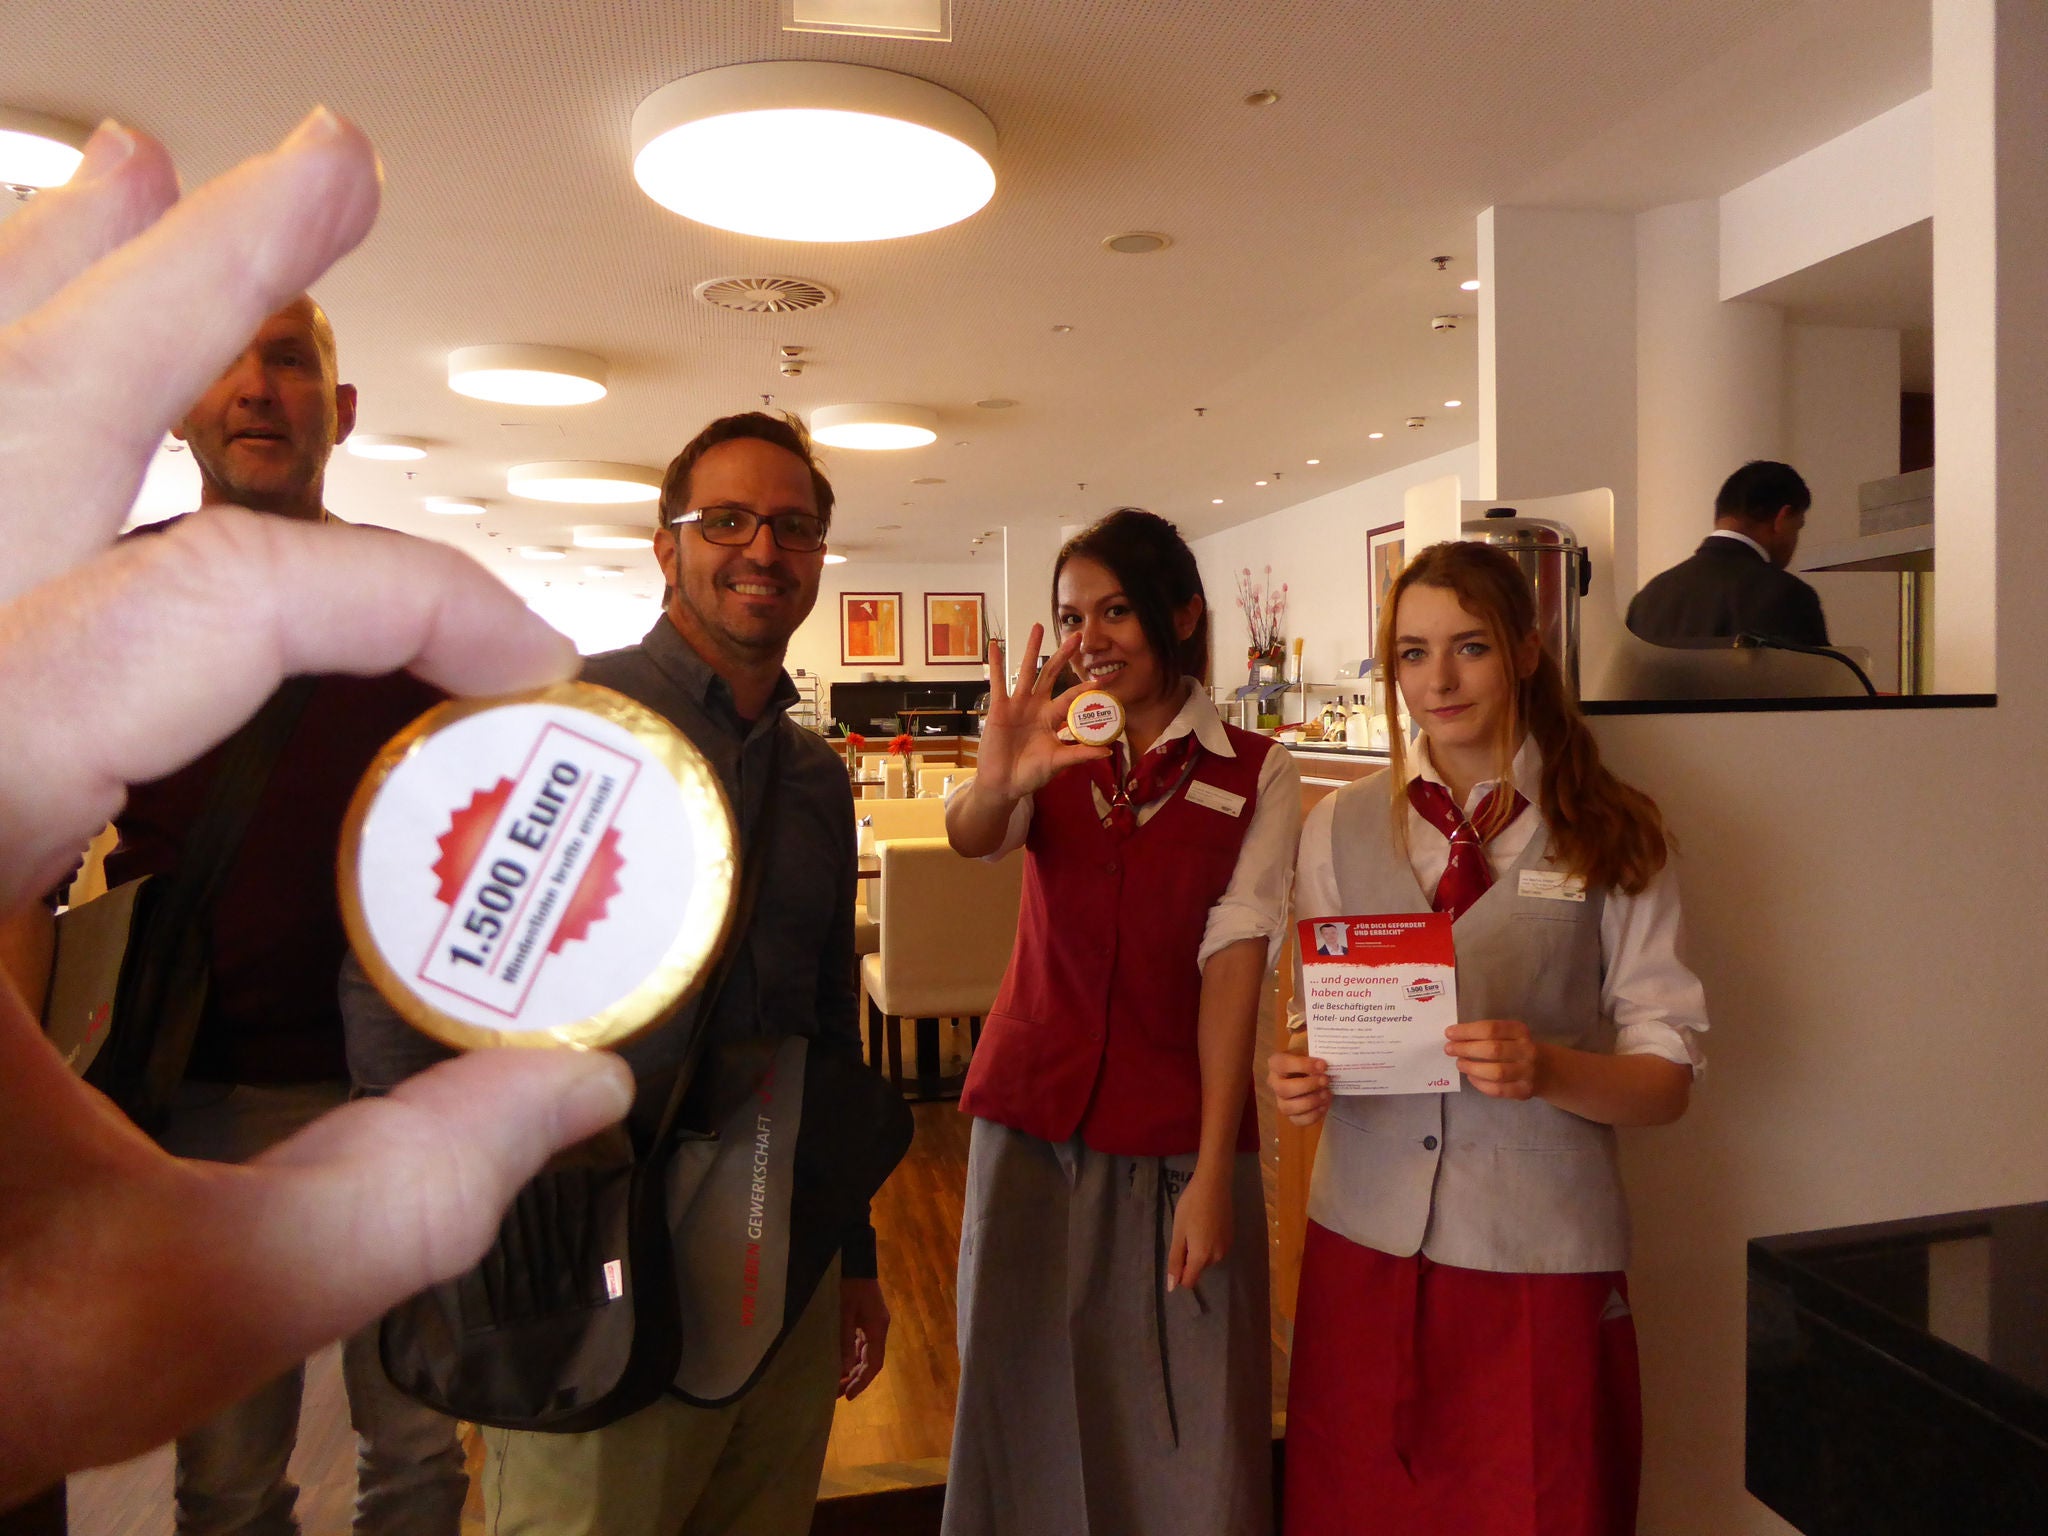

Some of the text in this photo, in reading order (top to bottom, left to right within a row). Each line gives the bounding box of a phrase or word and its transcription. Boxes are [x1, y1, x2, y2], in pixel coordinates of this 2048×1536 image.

[1078, 712, 1095, 720] 1.500
[449, 760, 581, 968] 1.500 Euro
[1387, 921, 1426, 929] GEFORDERT
[1321, 975, 1341, 984] und
[1343, 977, 1399, 987] gewonnen
[1311, 988, 1372, 998] haben auch
[1312, 1002, 1396, 1012] die Beschäftigten im
[1313, 1014, 1413, 1024] Hotel- und Gastgewerbe
[1427, 1077, 1450, 1087] vida
[748, 1114, 772, 1239] GEWERKSCHAFT
